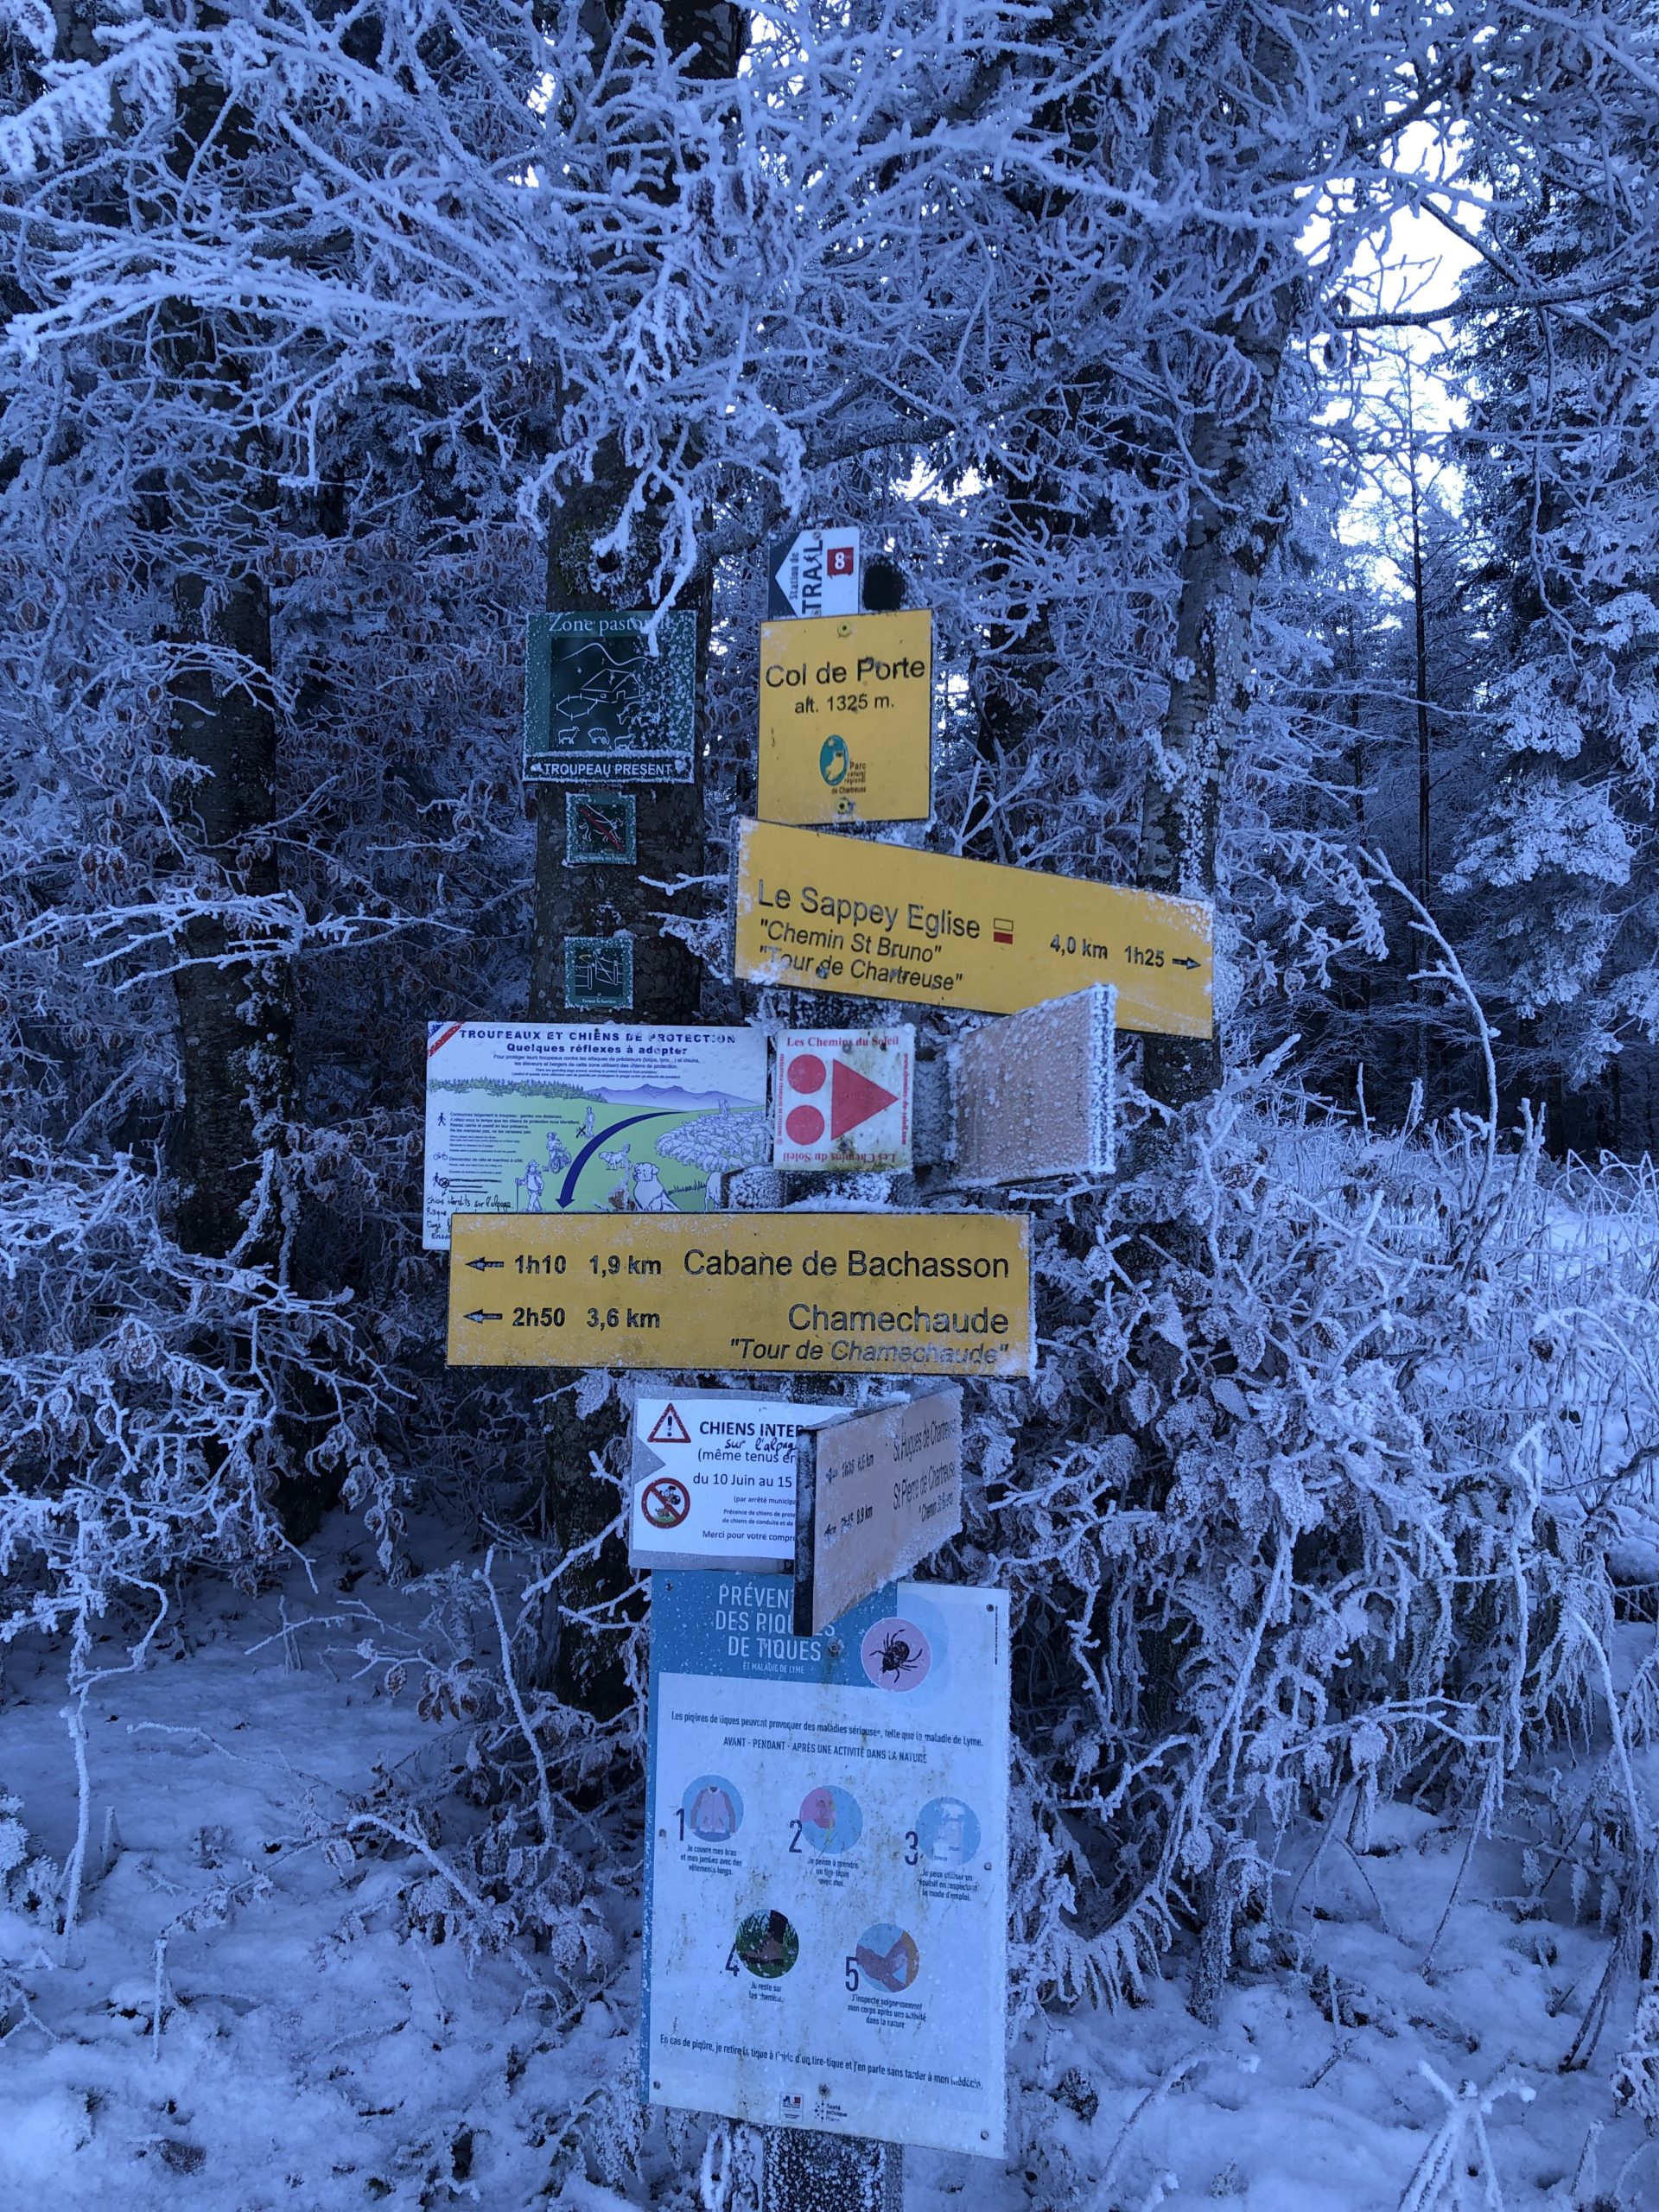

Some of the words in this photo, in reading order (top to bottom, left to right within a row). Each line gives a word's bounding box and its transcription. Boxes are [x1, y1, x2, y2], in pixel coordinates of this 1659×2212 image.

[790, 552, 799, 563] de
[835, 551, 845, 570] 8
[789, 566, 799, 600] Station
[549, 613, 594, 632] Zone
[599, 614, 674, 637] pastole
[766, 663, 807, 688] Col
[816, 661, 847, 684] de
[857, 656, 925, 683] Porte
[794, 696, 819, 715] alt.
[827, 694, 868, 713] 1325
[874, 696, 894, 709] m.
[544, 763, 611, 777] TROUPEAU
[614, 763, 672, 776] PRESENT
[849, 761, 866, 770] Parc
[758, 879, 791, 909] Le
[800, 885, 899, 932] Sappey
[907, 903, 981, 939] Eglise
[760, 918, 844, 950] "Chemin
[850, 932, 872, 954] St
[877, 937, 942, 963] Bruno"
[1050, 933, 1077, 957] 4,0
[1082, 938, 1108, 960] km
[760, 945, 814, 972] "Tour
[817, 955, 843, 976] de
[850, 958, 963, 991] Chartreuse"
[1124, 945, 1165, 968] 1h25
[460, 1029, 541, 1040] TROUPEAUX
[547, 1031, 563, 1040] ET
[569, 1032, 620, 1042] CHIENS
[626, 1033, 643, 1042] DE
[786, 1037, 804, 1047] Les
[808, 1037, 853, 1047] Chemins
[856, 1036, 869, 1046] du
[871, 1035, 899, 1046] Soleil
[506, 1043, 565, 1054] Quelques
[570, 1044, 621, 1054] réflexes
[626, 1045, 633, 1054] à
[639, 1046, 688, 1056] adopter
[783, 1152, 811, 1163] Soleil
[815, 1153, 828, 1163] du
[830, 1153, 875, 1163] Chemins
[878, 1153, 897, 1163] Les
[514, 1255, 567, 1274] 1h10
[589, 1255, 620, 1278] 1,9
[628, 1255, 661, 1274] km
[684, 1249, 792, 1276] Cabane
[802, 1249, 837, 1276] de
[848, 1249, 1009, 1278] Bachasson
[512, 1307, 566, 1327] 2h50
[587, 1307, 620, 1331] 3,6
[626, 1307, 660, 1328] km
[788, 1303, 1008, 1334] Chamechaude
[731, 1338, 791, 1359] "Tour
[796, 1339, 823, 1360] de
[831, 1339, 1009, 1364] Chamechaude"
[699, 1421, 755, 1436] CHIENS
[923, 1423, 930, 1449] de
[698, 1448, 741, 1462] (même
[745, 1451, 779, 1464] tenus
[725, 1439, 746, 1449] sur
[693, 1472, 709, 1484] du
[713, 1473, 728, 1485] 10
[730, 1474, 754, 1486] Juin
[759, 1477, 773, 1487] au
[778, 1476, 792, 1488] 15
[893, 1482, 900, 1510] St
[901, 1477, 919, 1507] Pierre
[919, 1471, 927, 1496] de
[715, 1610, 749, 1631] DES
[728, 1636, 750, 1657] DE
[756, 1637, 822, 1662] TIQUES
[743, 1662, 750, 1671] ET
[752, 1662, 778, 1673] MALADIE
[779, 1664, 787, 1673] DE
[789, 1665, 804, 1674] LYME
[671, 1710, 683, 1720] Les
[684, 1712, 709, 1724] piqûres
[709, 1713, 718, 1724] de
[720, 1715, 740, 1726] tiques
[741, 1718, 767, 1728] peuvent
[769, 1719, 802, 1732] provoquer
[804, 1721, 816, 1731] des
[817, 1723, 847, 1734] maladies
[885, 1728, 900, 1739] telle
[901, 1732, 914, 1742] que
[925, 1733, 951, 1744] maladie
[953, 1734, 962, 1745] de
[963, 1736, 984, 1747] Lyme.
[723, 1737, 746, 1747] AVANT
[753, 1738, 785, 1751] PENDANT
[792, 1741, 816, 1753] APRÈS
[817, 1745, 831, 1755] UNE
[834, 1745, 864, 1758] ACTIVITÉ
[867, 1748, 887, 1760] DANS
[899, 1751, 927, 1764] NATURE
[676, 1808, 684, 1841] 1
[789, 1819, 803, 1853] 2
[905, 1830, 918, 1866] 3
[725, 1942, 740, 1977] 4
[845, 1956, 859, 1992] 5
[660, 2034, 669, 2044] En
[670, 2037, 682, 2046] cas
[683, 2037, 691, 2047] de
[692, 2039, 715, 2052] piqûre,
[715, 2042, 722, 2053] je
[723, 2044, 742, 2056] retire
[751, 2049, 768, 2061] tique
[769, 2050, 773, 2061] à
[795, 2053, 810, 2065] d'un
[812, 2055, 843, 2071] tire-tique
[845, 2061, 853, 2070] et
[853, 2061, 866, 2072] j'en
[868, 2063, 885, 2075] parle
[887, 2068, 903, 2078] sans
[906, 2069, 926, 2082] tarder
[928, 2072, 932, 2082] à
[934, 2075, 950, 2084] mon
